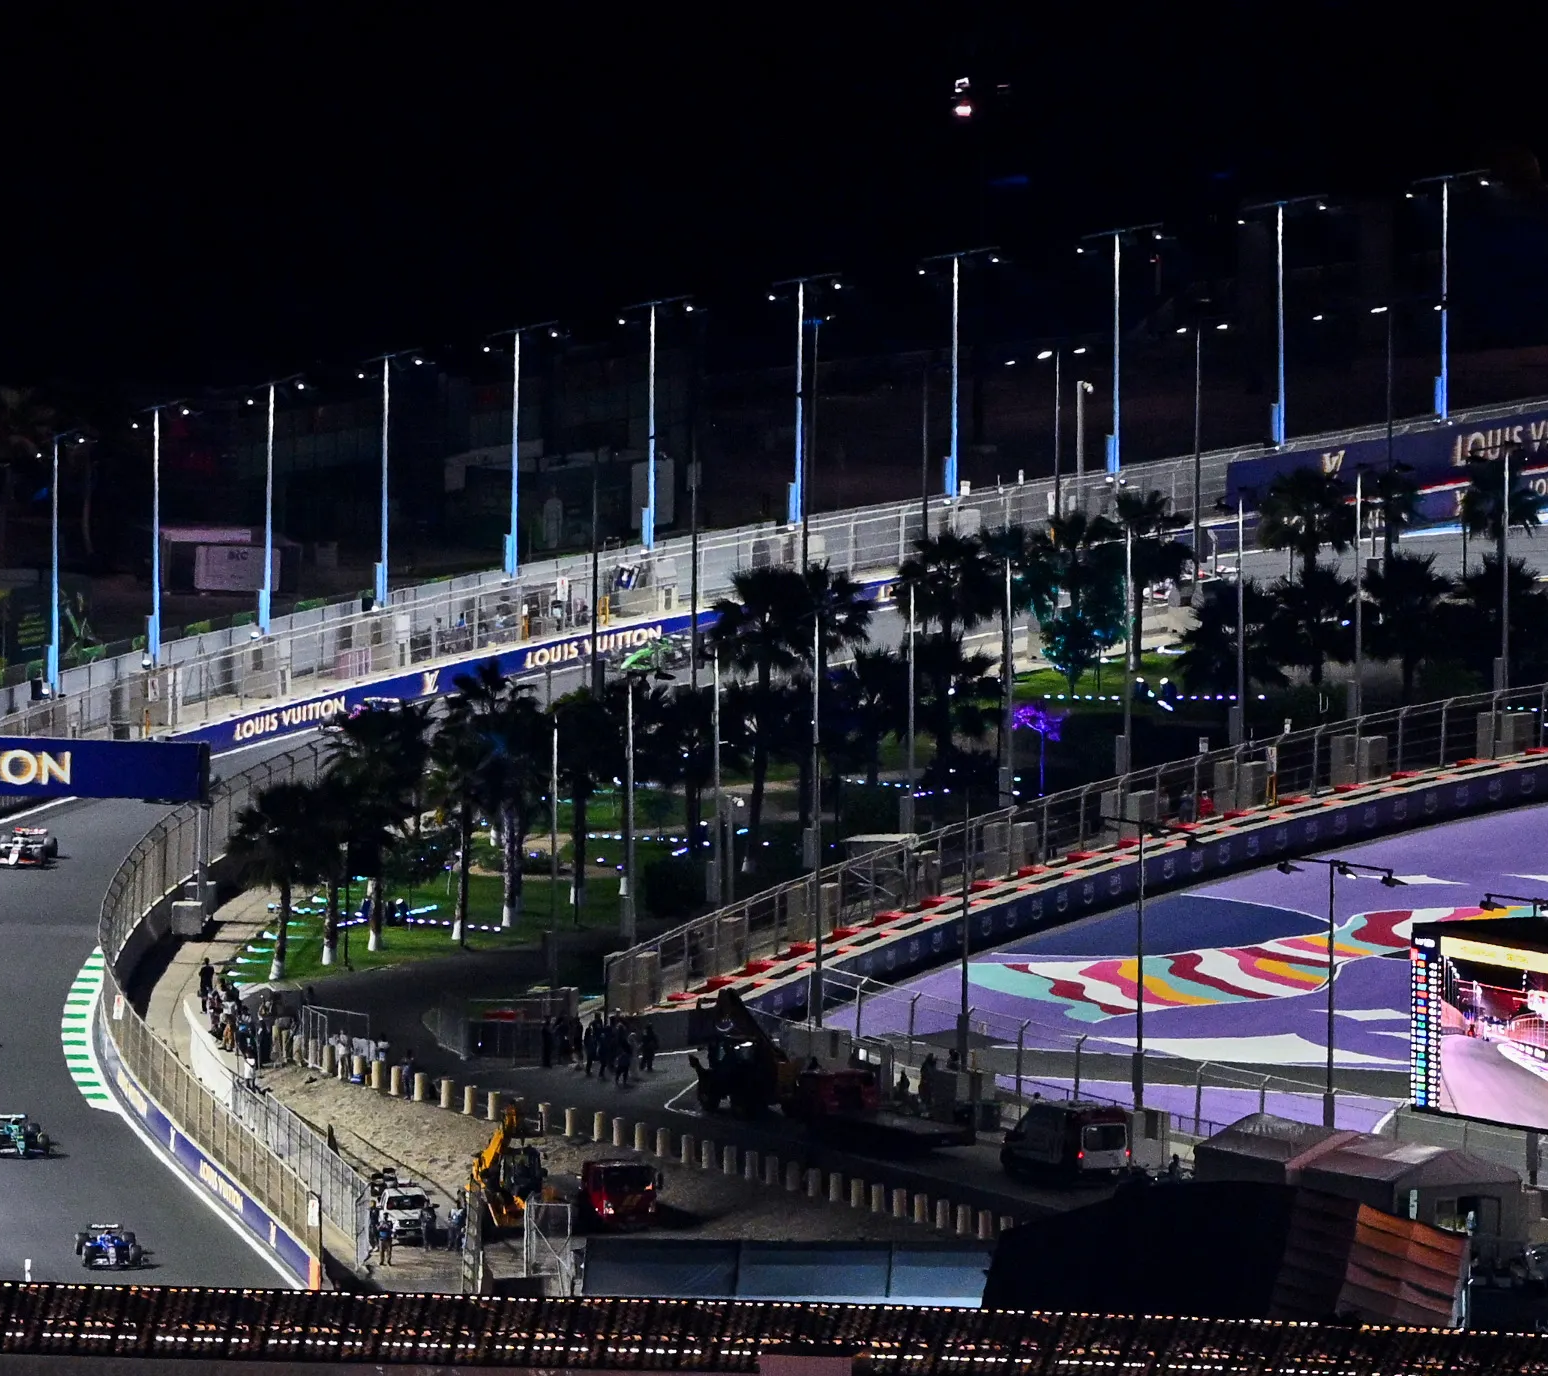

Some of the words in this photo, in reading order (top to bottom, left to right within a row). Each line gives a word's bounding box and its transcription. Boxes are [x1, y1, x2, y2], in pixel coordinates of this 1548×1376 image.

[1452, 419, 1524, 467] LOUIS
[524, 638, 578, 668] LOUIS
[585, 625, 663, 655] VUITTON
[233, 714, 279, 742] LOUIS
[281, 700, 347, 732] VUITTON
